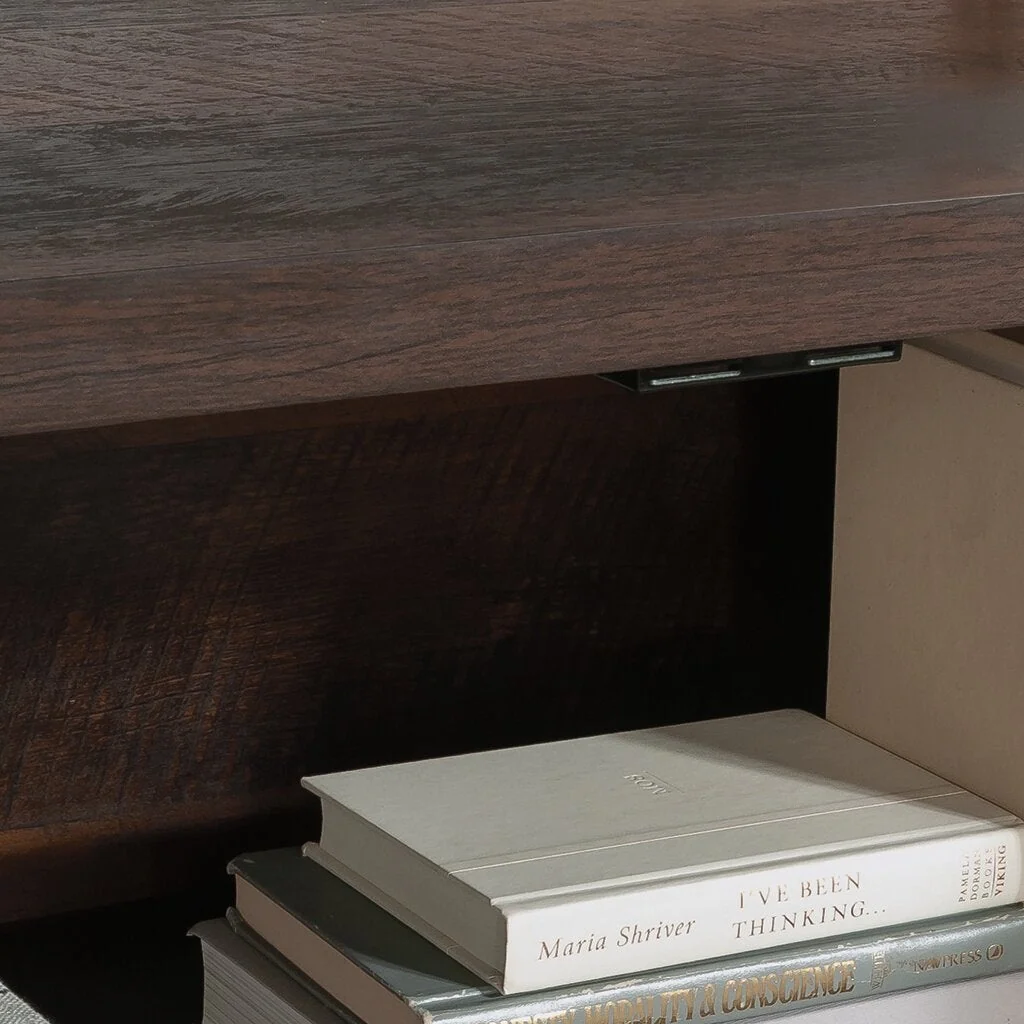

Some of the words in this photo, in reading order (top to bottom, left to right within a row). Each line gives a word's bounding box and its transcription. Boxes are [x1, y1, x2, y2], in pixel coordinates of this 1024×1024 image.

[738, 882, 789, 910] I'VE
[800, 871, 862, 899] BEEN
[994, 845, 1007, 896] VIKING
[538, 934, 608, 961] Maria
[616, 918, 697, 948] Shriver
[700, 983, 717, 1018] &
[721, 960, 857, 1014] CONSCIENCE
